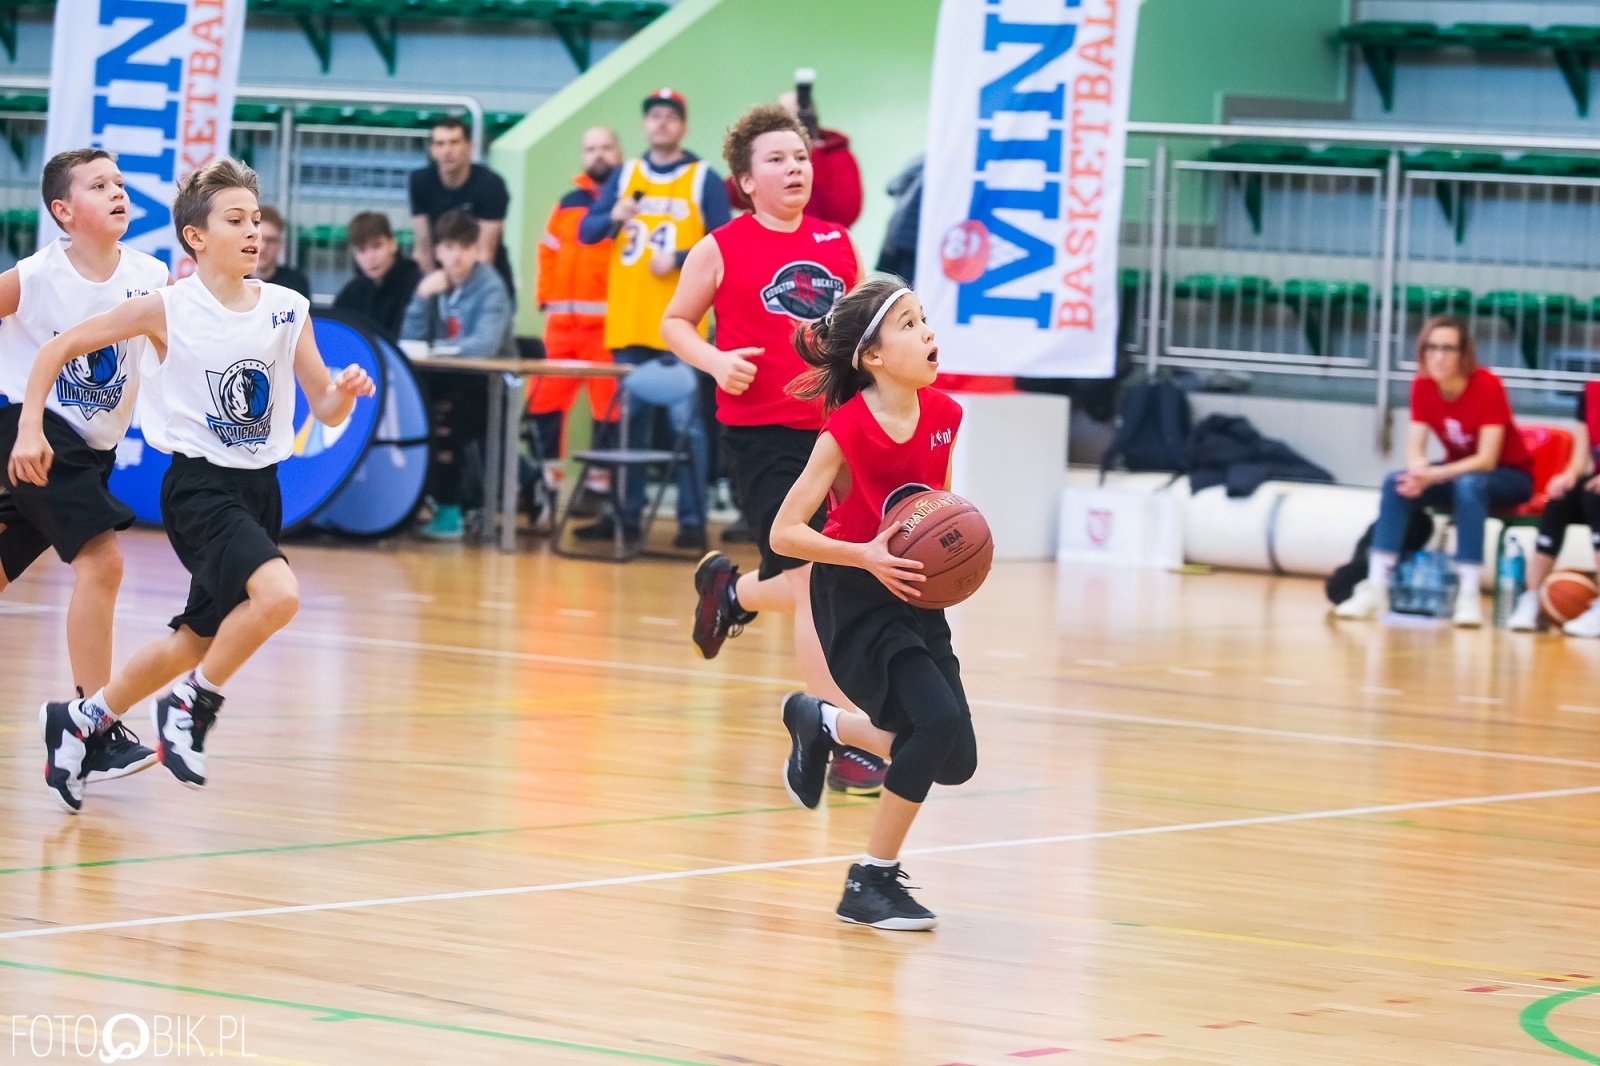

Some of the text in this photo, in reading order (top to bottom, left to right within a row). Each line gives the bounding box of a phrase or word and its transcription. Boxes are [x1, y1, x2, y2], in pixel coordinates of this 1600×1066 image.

[956, 0, 1083, 329] MIN
[621, 219, 677, 266] 34
[58, 376, 123, 406] MAVERICKS
[211, 417, 272, 445] MAVERICKS
[939, 528, 963, 548] NBA
